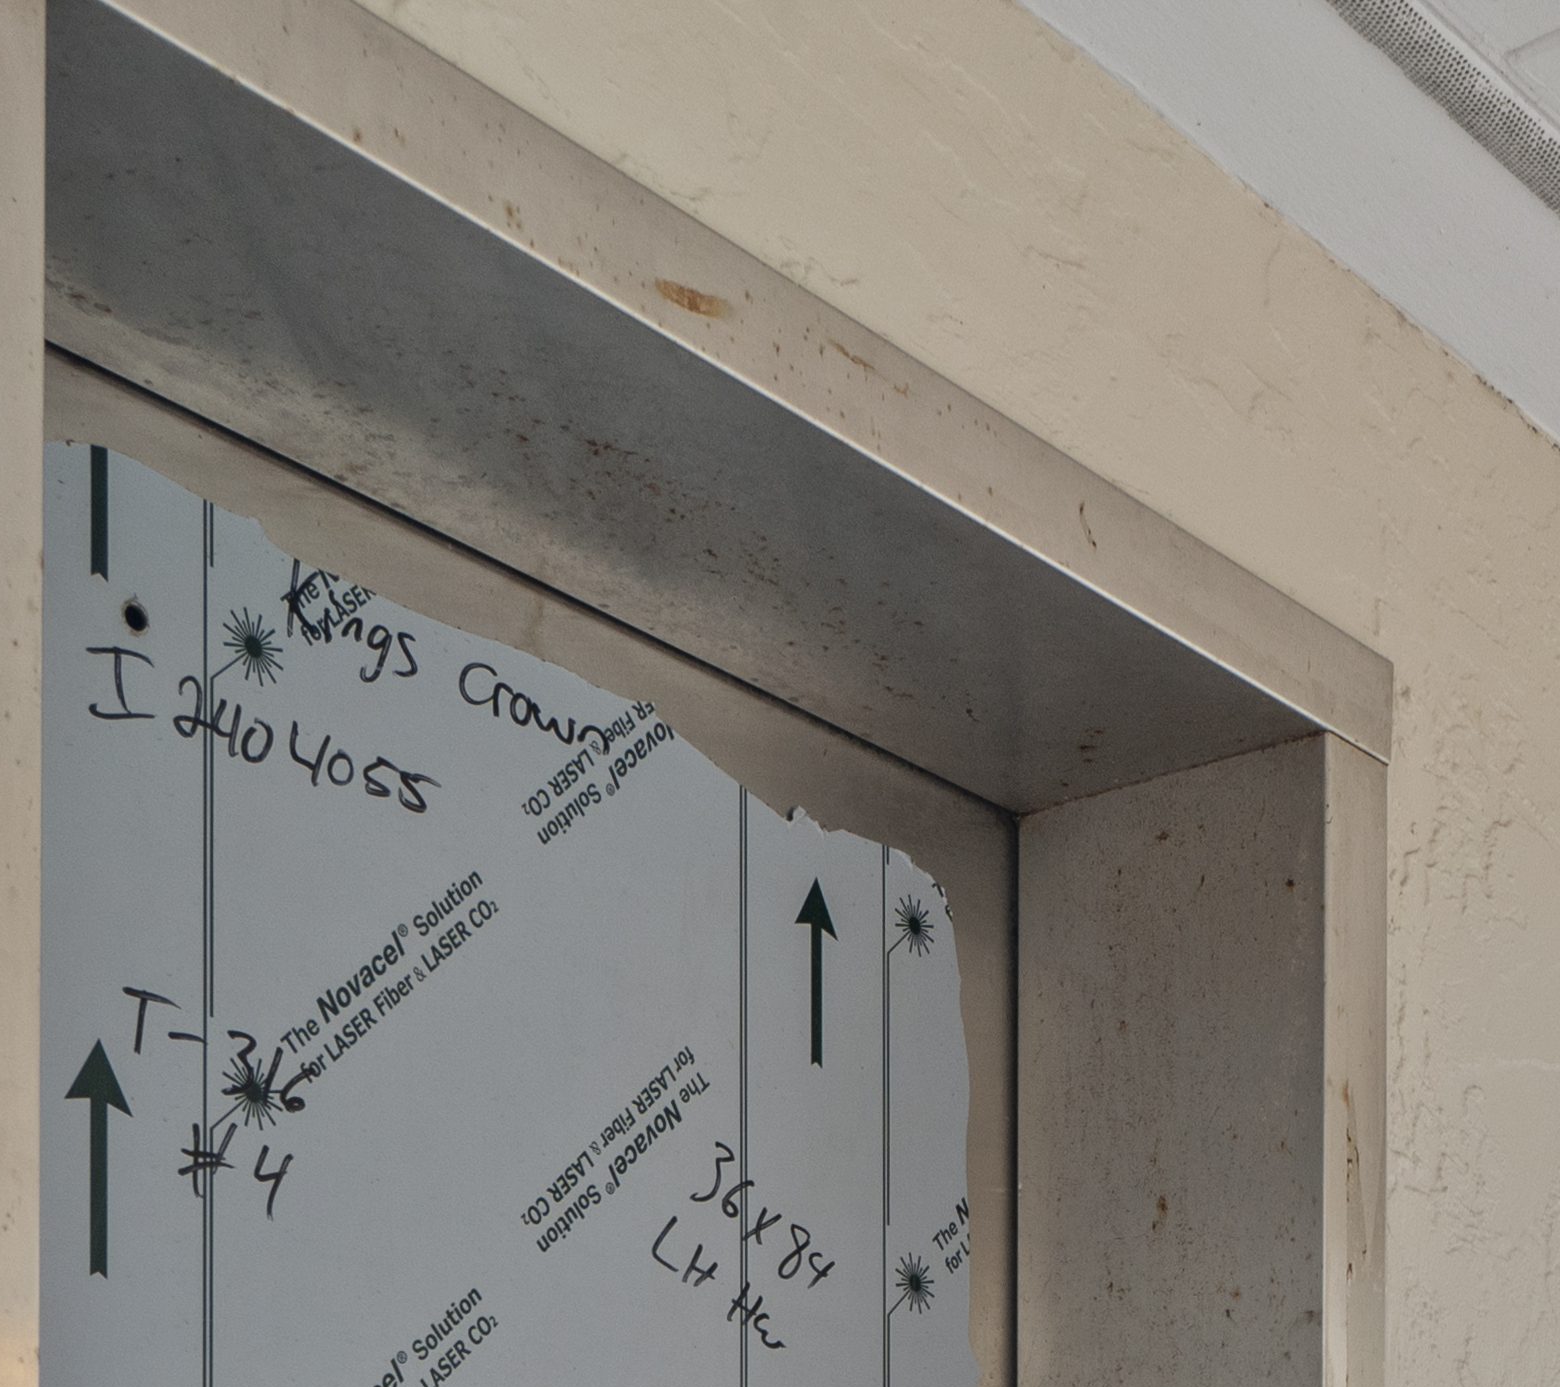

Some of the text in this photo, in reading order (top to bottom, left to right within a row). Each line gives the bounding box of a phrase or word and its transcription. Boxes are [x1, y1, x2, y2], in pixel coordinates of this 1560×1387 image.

[547, 748, 595, 797] LASER
[537, 782, 603, 845] Solution
[279, 1018, 321, 1055] The
[412, 870, 484, 937] Solution
[299, 1053, 327, 1084] for
[322, 1007, 379, 1063] LASER
[372, 973, 415, 1017] Fiber
[412, 966, 427, 983] &
[420, 920, 473, 973] LASER
[673, 1045, 696, 1073] for
[631, 1064, 677, 1115] LASER
[678, 1071, 711, 1104] The
[599, 1106, 637, 1149] Fiber
[545, 1150, 595, 1203] LASER
[536, 1184, 602, 1253] Solution
[931, 1221, 959, 1251] The
[945, 1249, 963, 1274] for
[411, 1287, 483, 1361] Solution
